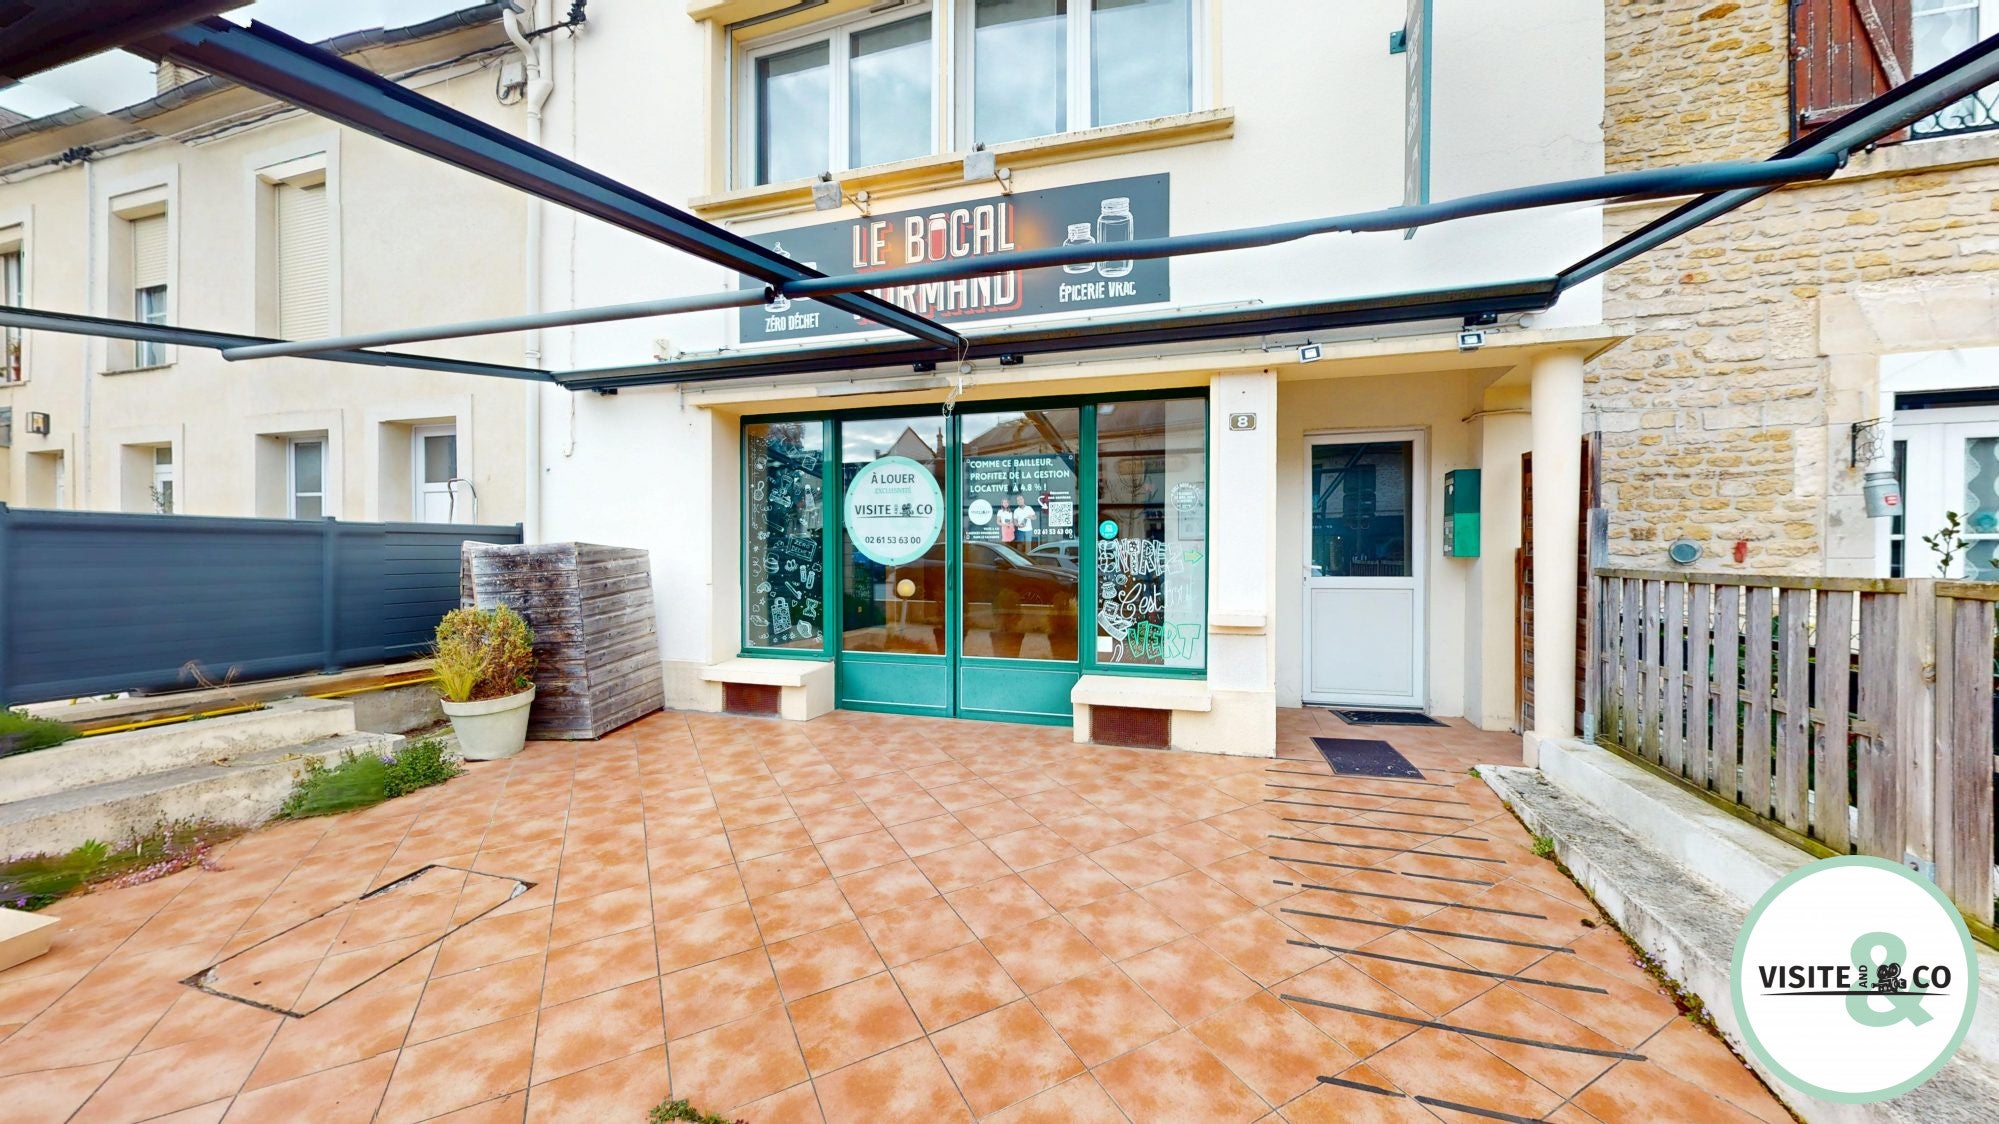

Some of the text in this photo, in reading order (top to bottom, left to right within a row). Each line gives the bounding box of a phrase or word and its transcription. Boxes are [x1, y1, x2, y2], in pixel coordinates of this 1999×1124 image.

[853, 221, 886, 268] LE
[853, 268, 1015, 321] RMAND
[1059, 280, 1137, 302] ÉPICERIE VRAC
[765, 312, 820, 332] ZÉRO DÉCHET
[1237, 416, 1248, 428] 8
[970, 458, 1053, 469] COMME CE BAILLEUR,
[871, 472, 915, 484] À LOUER
[970, 470, 1070, 481] PROFITEZ DE LA GESTION
[970, 484, 1008, 493] LOCATIVE
[854, 504, 891, 515] VISITE
[916, 504, 933, 515] CO
[865, 536, 921, 544] 02 61 53 63 00
[1127, 620, 1201, 660] VERT
